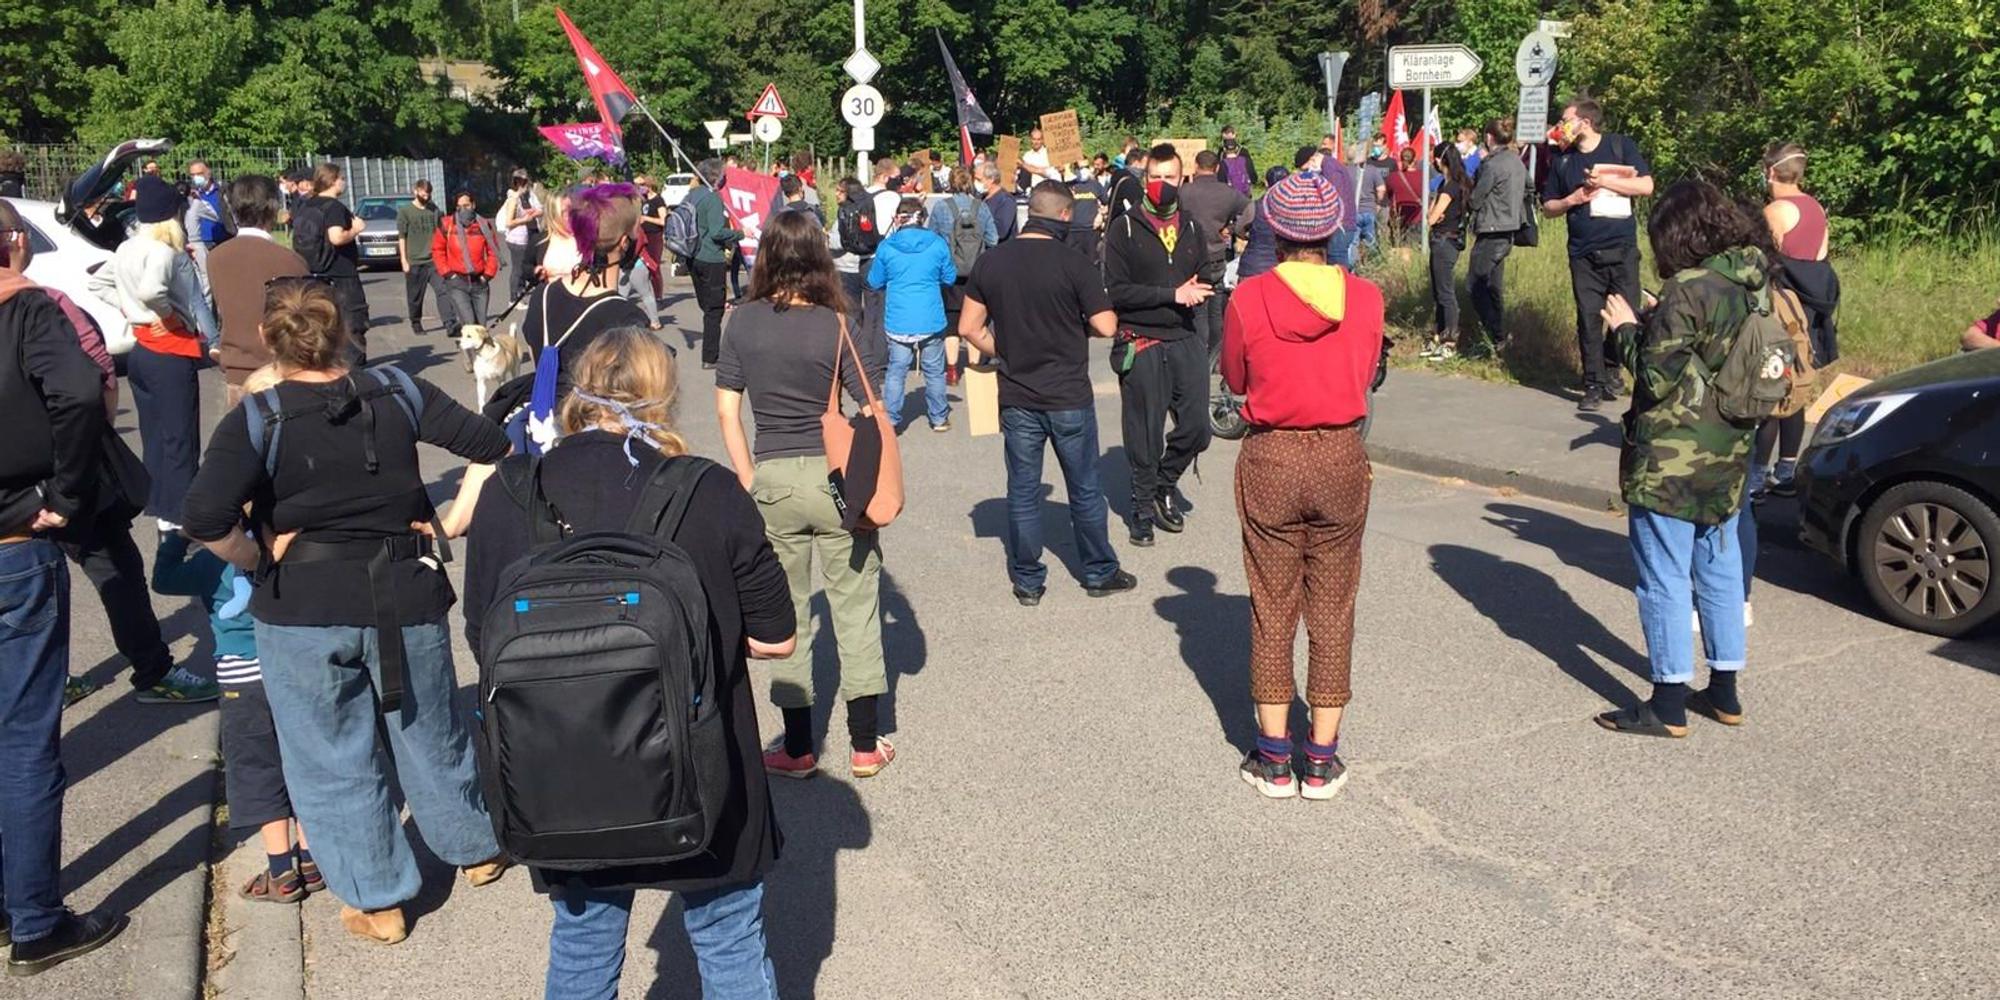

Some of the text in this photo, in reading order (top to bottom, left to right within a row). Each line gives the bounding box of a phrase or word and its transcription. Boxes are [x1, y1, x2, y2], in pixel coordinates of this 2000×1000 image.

[1403, 53, 1455, 67] Kläranlage
[1406, 68, 1452, 81] Bornheim
[851, 97, 875, 116] 30
